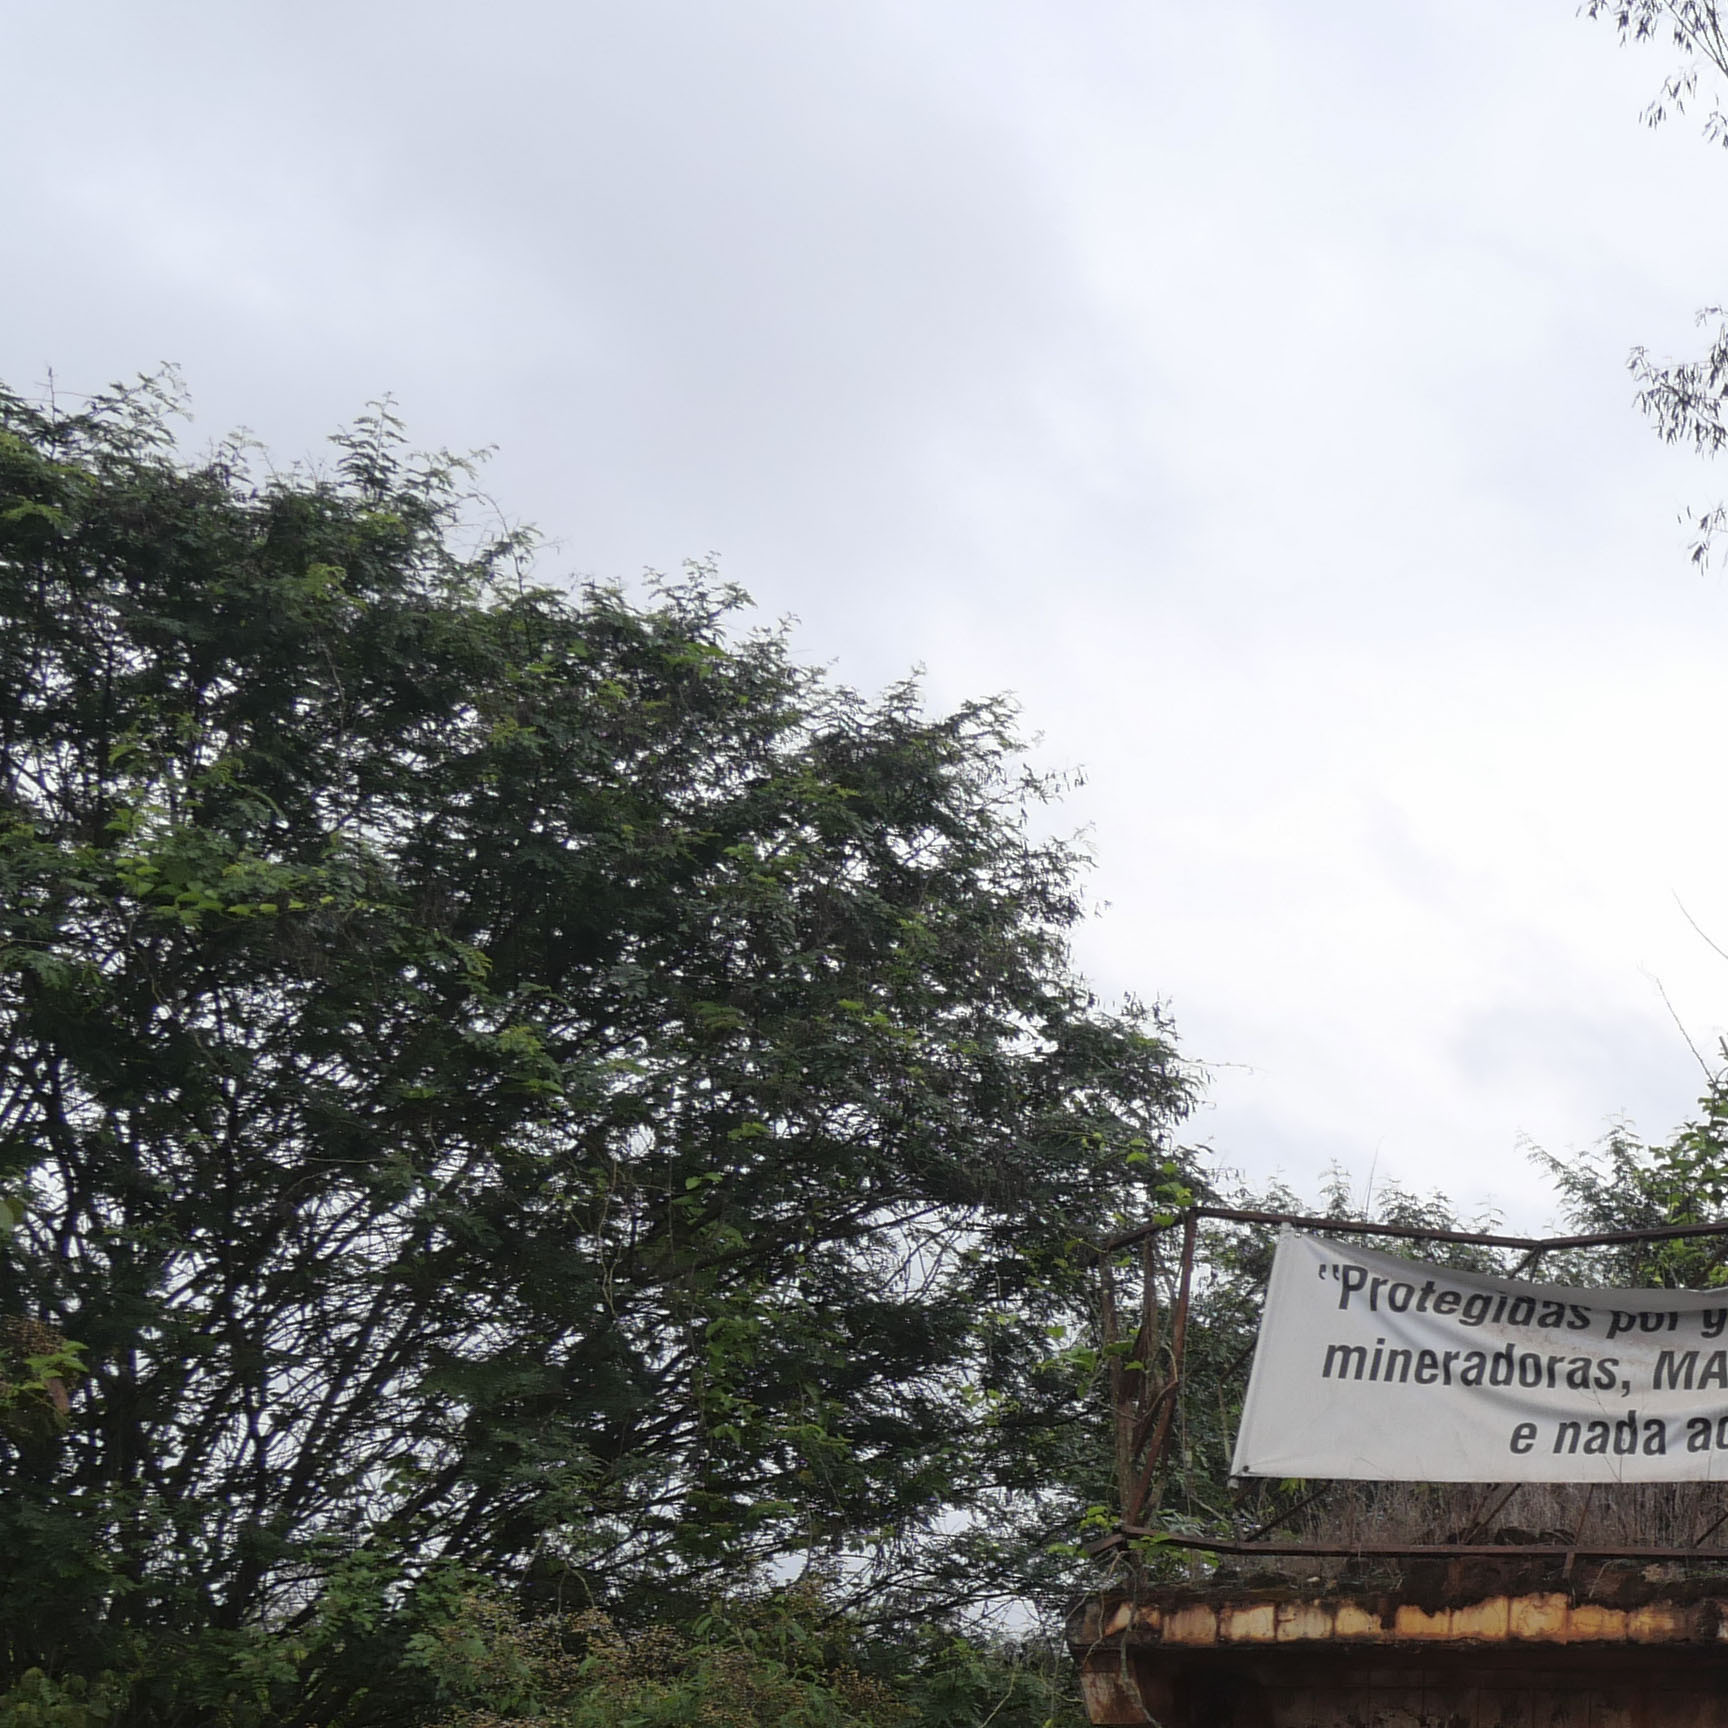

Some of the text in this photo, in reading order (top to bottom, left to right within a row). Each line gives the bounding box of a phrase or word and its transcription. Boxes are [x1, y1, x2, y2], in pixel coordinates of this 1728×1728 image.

[1322, 1338, 1631, 1398] mineradoras,
[1509, 1421, 1537, 1454] e
[1552, 1409, 1667, 1456] nada
